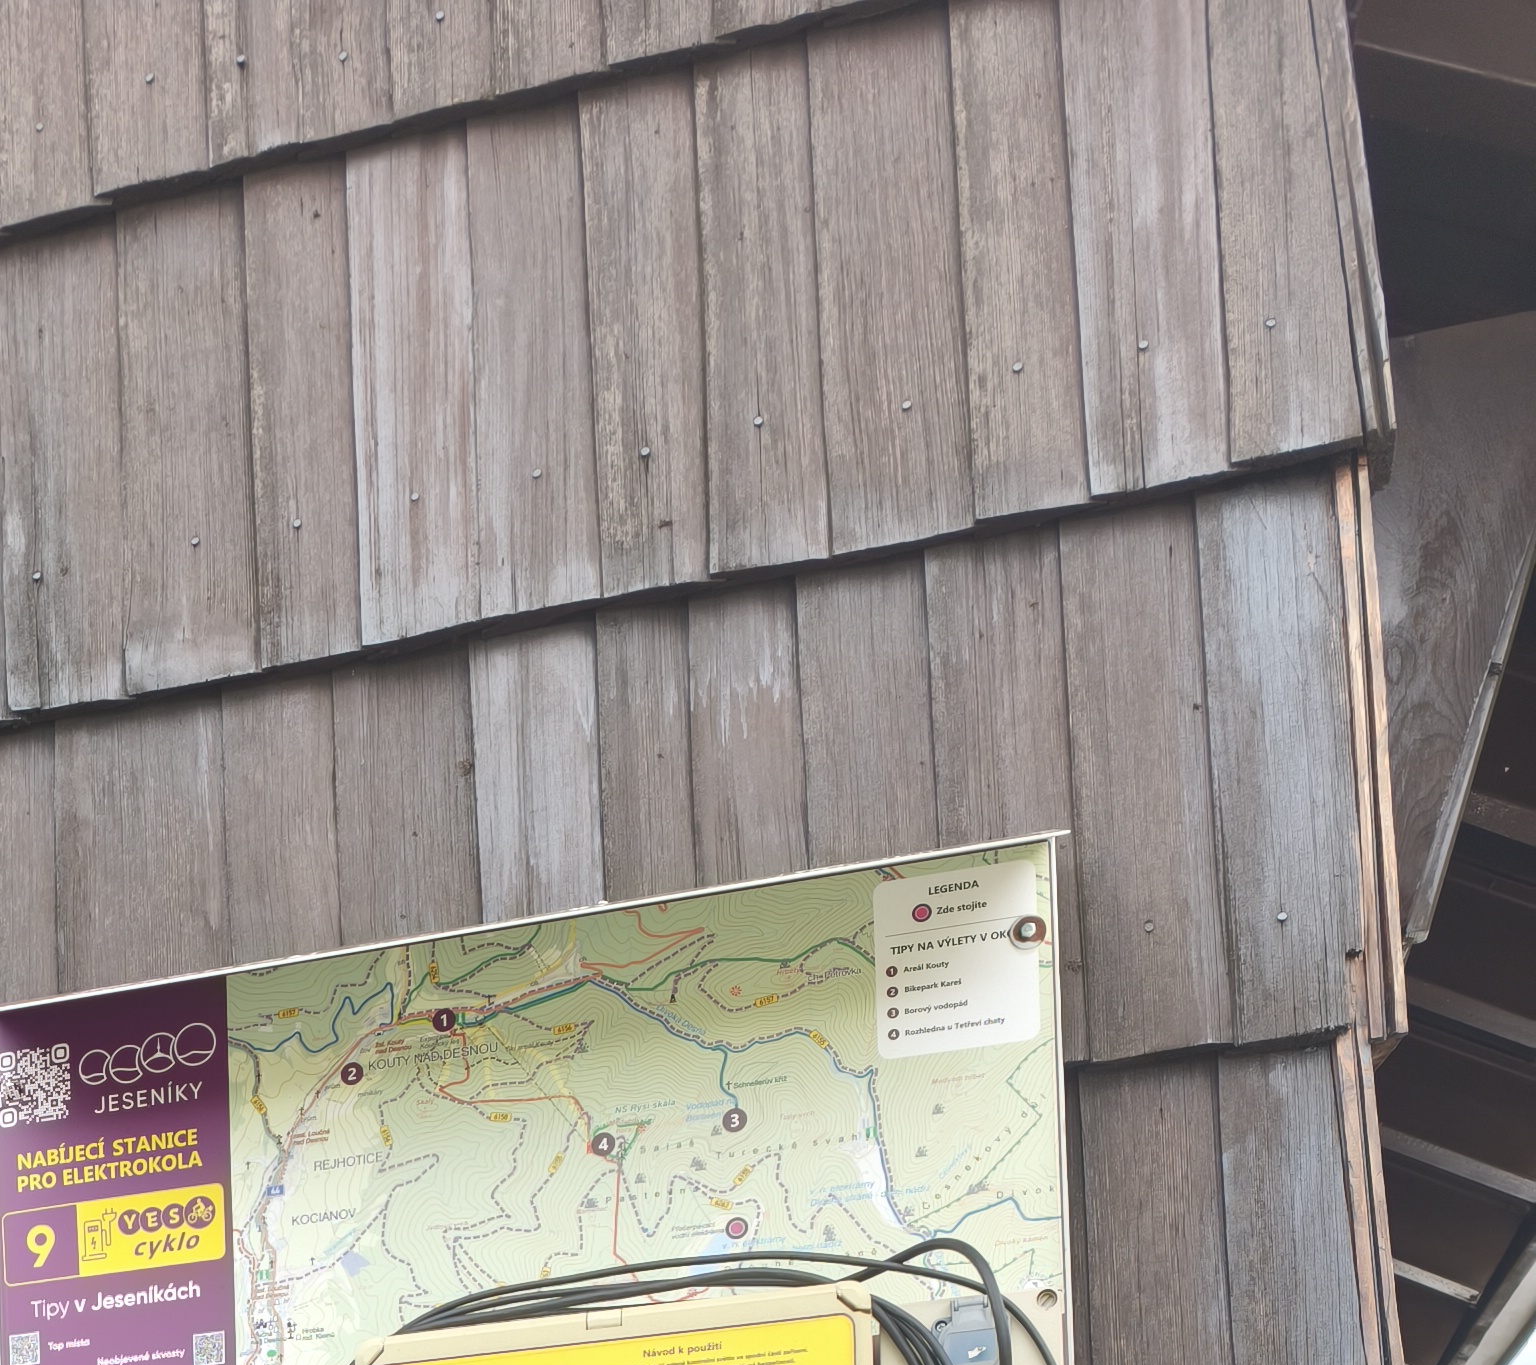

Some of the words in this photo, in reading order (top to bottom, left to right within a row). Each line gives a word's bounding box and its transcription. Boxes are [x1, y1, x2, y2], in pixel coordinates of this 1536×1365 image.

[928, 880, 979, 895] LEGENDA
[936, 905, 955, 915] Zde
[957, 900, 988, 913] stojíte
[890, 944, 914, 955] TIPY
[917, 941, 934, 952] NA
[937, 933, 977, 948] VÝLETY
[980, 933, 988, 942] V
[903, 963, 924, 973] Areál
[926, 960, 950, 971] Kouty
[904, 981, 939, 993] Bikepark
[904, 1004, 932, 1015] Borový
[905, 1024, 945, 1036] Rozhledna
[368, 1056, 411, 1071] KOUTY
[414, 1051, 441, 1063] NAD
[442, 1042, 499, 1060] DESNOU
[94, 1081, 203, 1114] JESENÍKY
[17, 1137, 105, 1171] NABÍJECÍ
[112, 1128, 198, 1157] STANICE
[314, 1151, 384, 1172] REJHOTICE
[17, 1172, 57, 1193] PRO
[62, 1150, 203, 1187] ELEKTROKOLA
[291, 1208, 357, 1226] KOCIÁNOV
[26, 1224, 56, 1268] 9
[121, 1206, 180, 1232] YES
[133, 1231, 201, 1261] cyklo
[30, 1299, 70, 1320] Tipy
[74, 1298, 86, 1313] v
[91, 1280, 201, 1312] Jeseníkách
[47, 1340, 64, 1352] Top
[65, 1337, 91, 1349] místa
[642, 1346, 675, 1358] Návod
[678, 1346, 684, 1354] k
[687, 1341, 723, 1355] použití
[152, 1348, 186, 1362] skvosty
